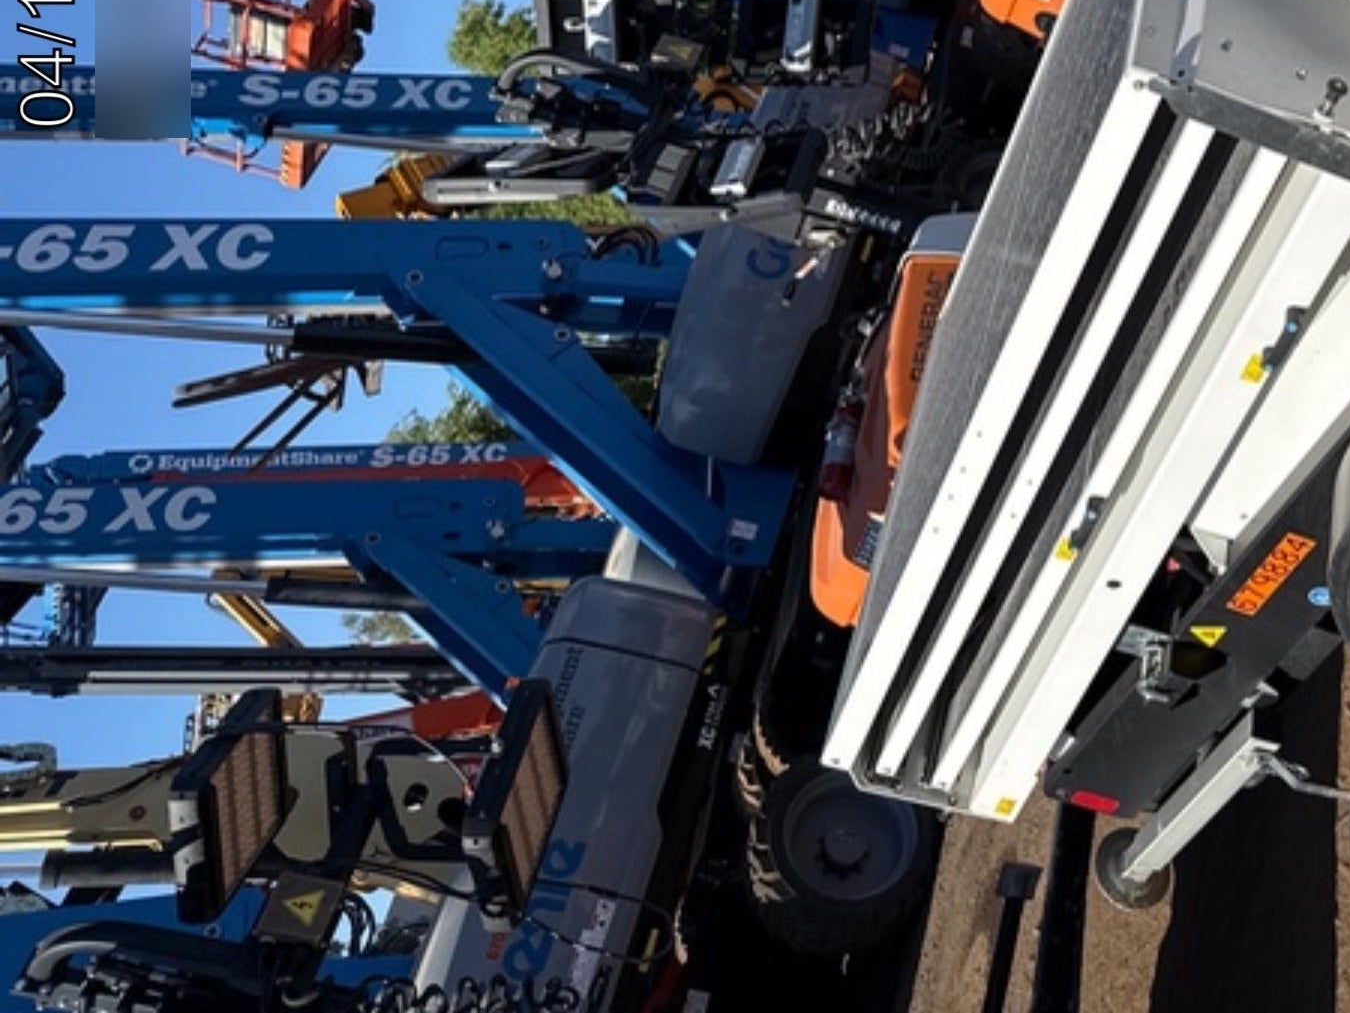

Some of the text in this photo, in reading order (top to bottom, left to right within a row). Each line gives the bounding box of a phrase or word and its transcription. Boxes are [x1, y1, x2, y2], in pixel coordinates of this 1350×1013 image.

[238, 74, 378, 108] S-65
[392, 78, 472, 110] XC
[149, 222, 275, 270] XC
[369, 444, 450, 468] S-65
[459, 442, 507, 463] XC
[102, 486, 218, 532] XC
